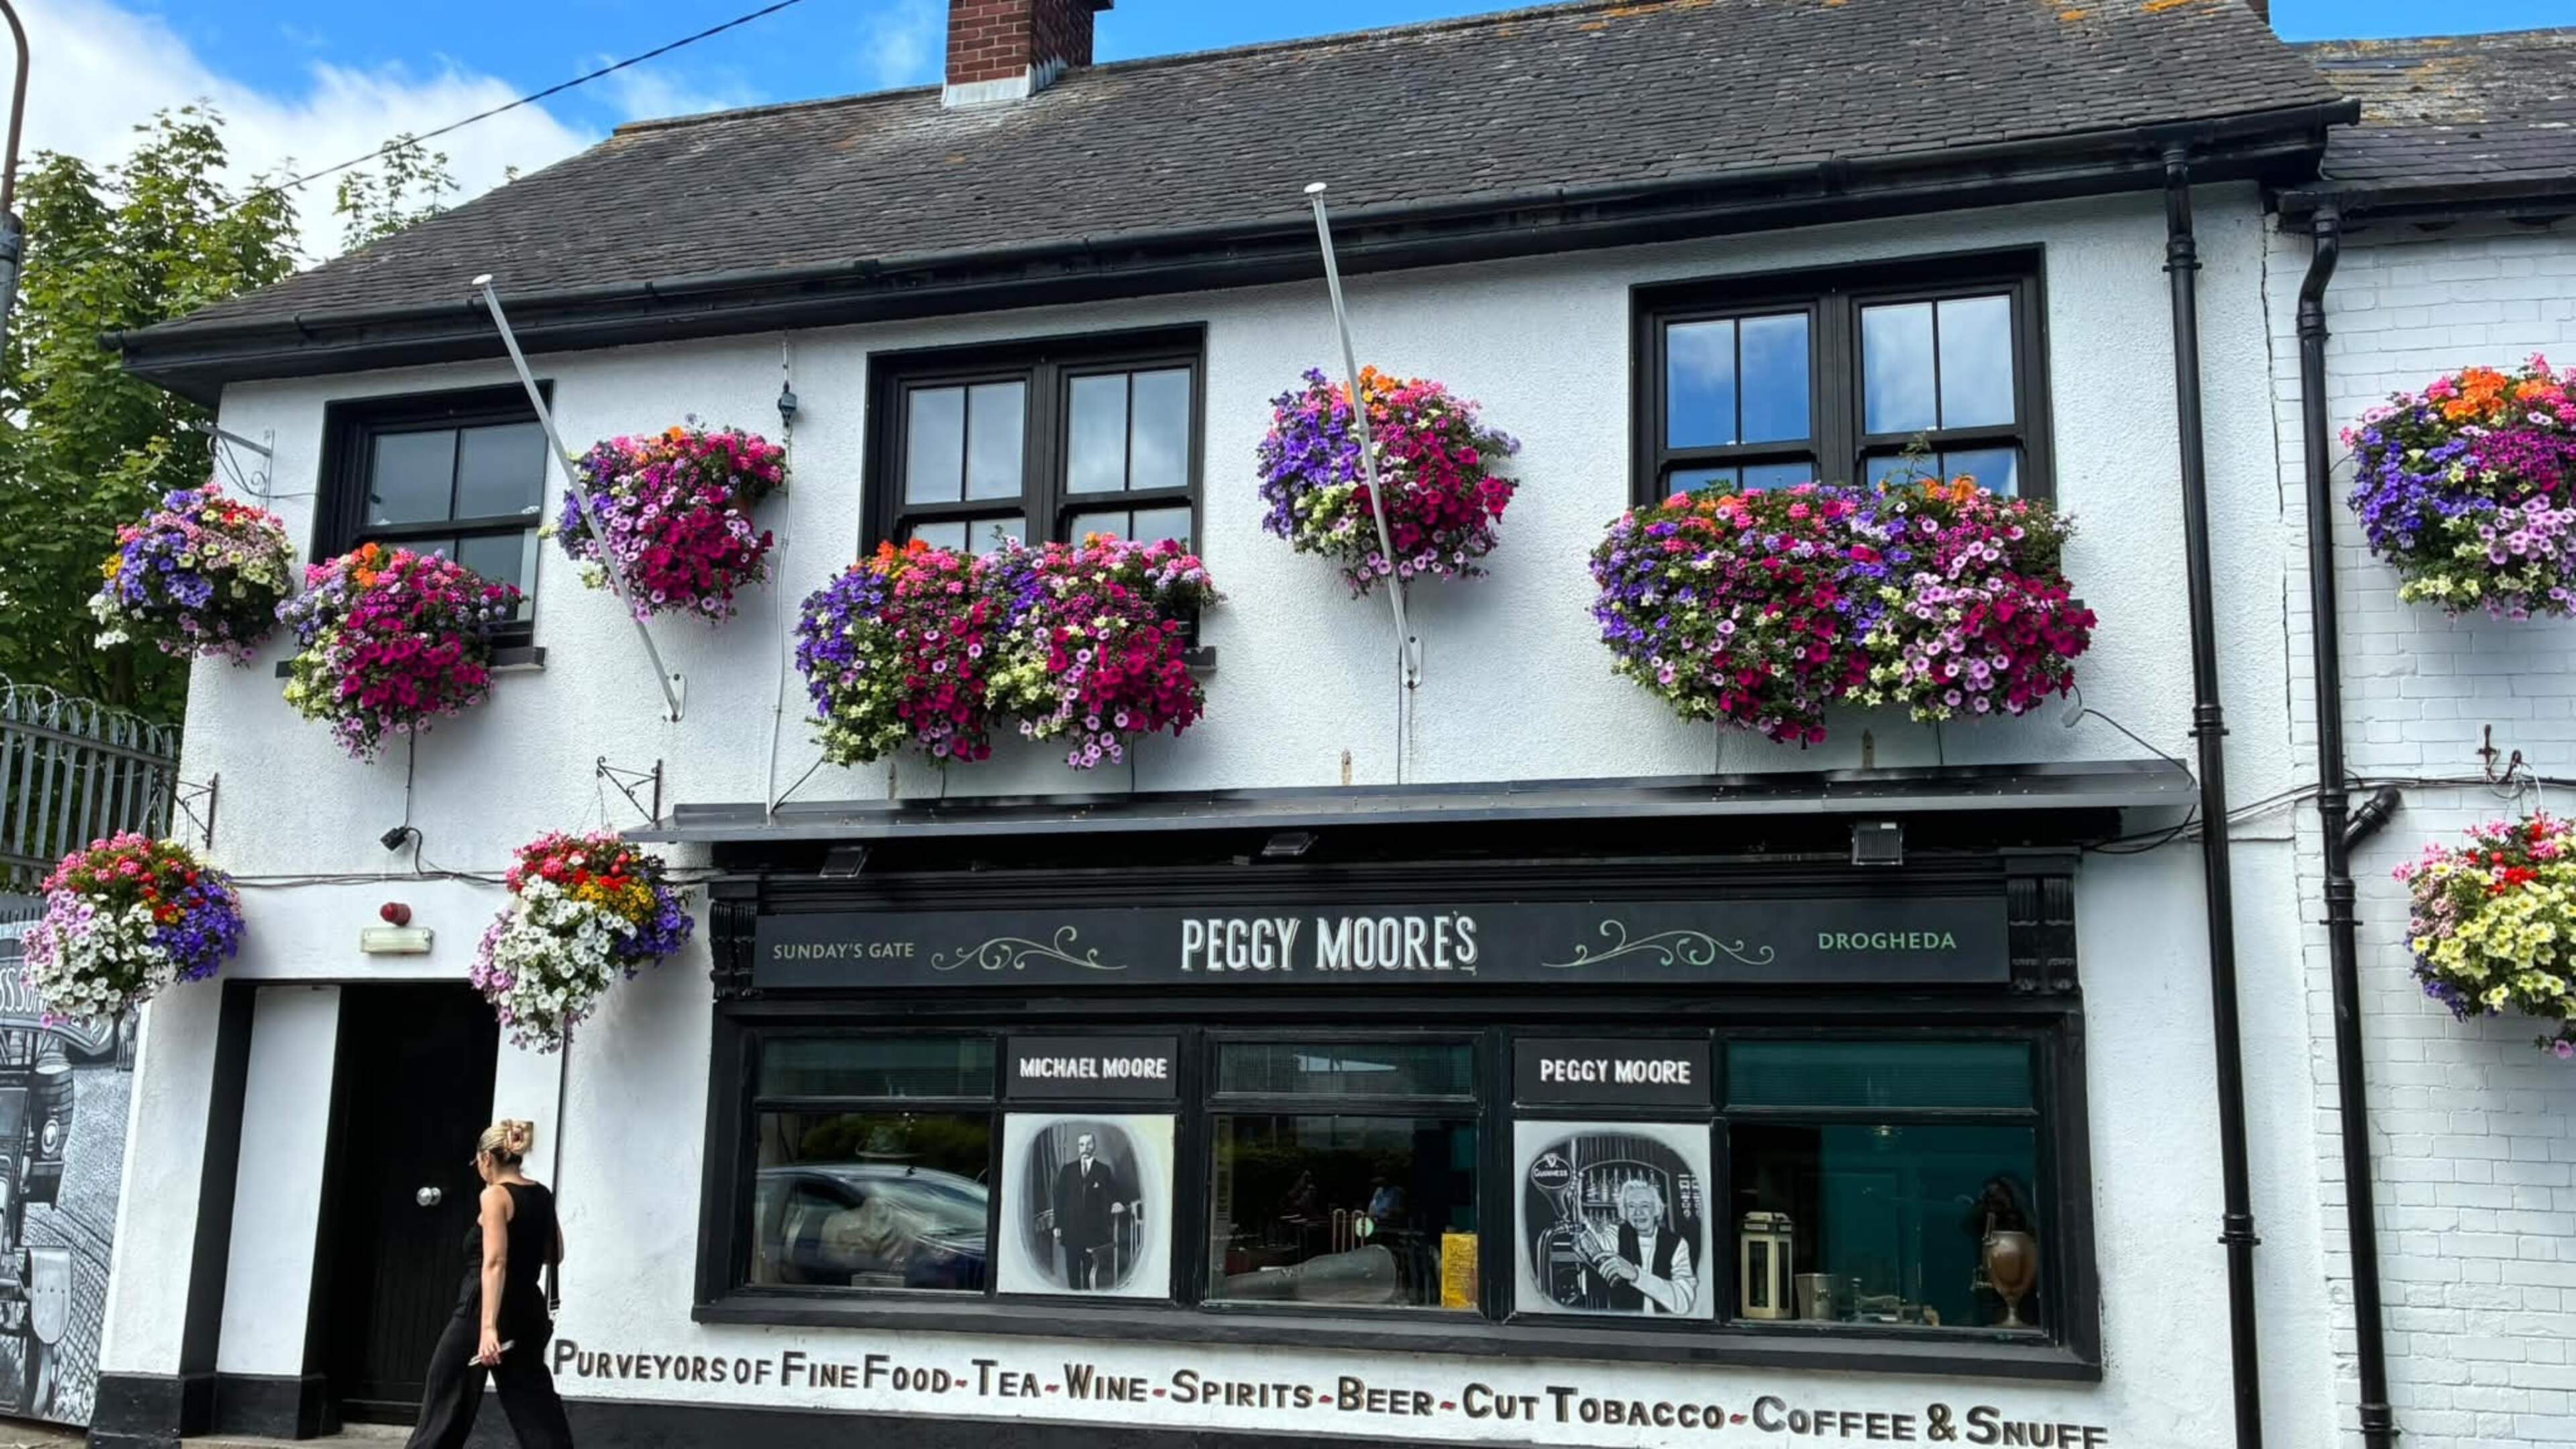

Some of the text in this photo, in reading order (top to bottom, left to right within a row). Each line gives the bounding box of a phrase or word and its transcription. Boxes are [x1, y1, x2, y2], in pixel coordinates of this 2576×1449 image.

[772, 942, 915, 960] SUNDAY'S GATE
[1181, 910, 1477, 976] PEGGY MOORE'S
[1818, 932, 1957, 951] DROGHEDA
[1019, 1057, 1168, 1079] MICHAEL MOORE
[1540, 1059, 1691, 1084] PEGGY MOORE
[553, 1339, 727, 1383] PURVEYORS
[734, 1357, 773, 1386] OF
[781, 1351, 859, 1389] FINE
[1462, 1382, 1540, 1421] CUT
[1752, 1395, 1917, 1442] COFFEE
[1927, 1403, 1957, 1442] &
[1966, 1405, 2109, 1449] SNUFF
